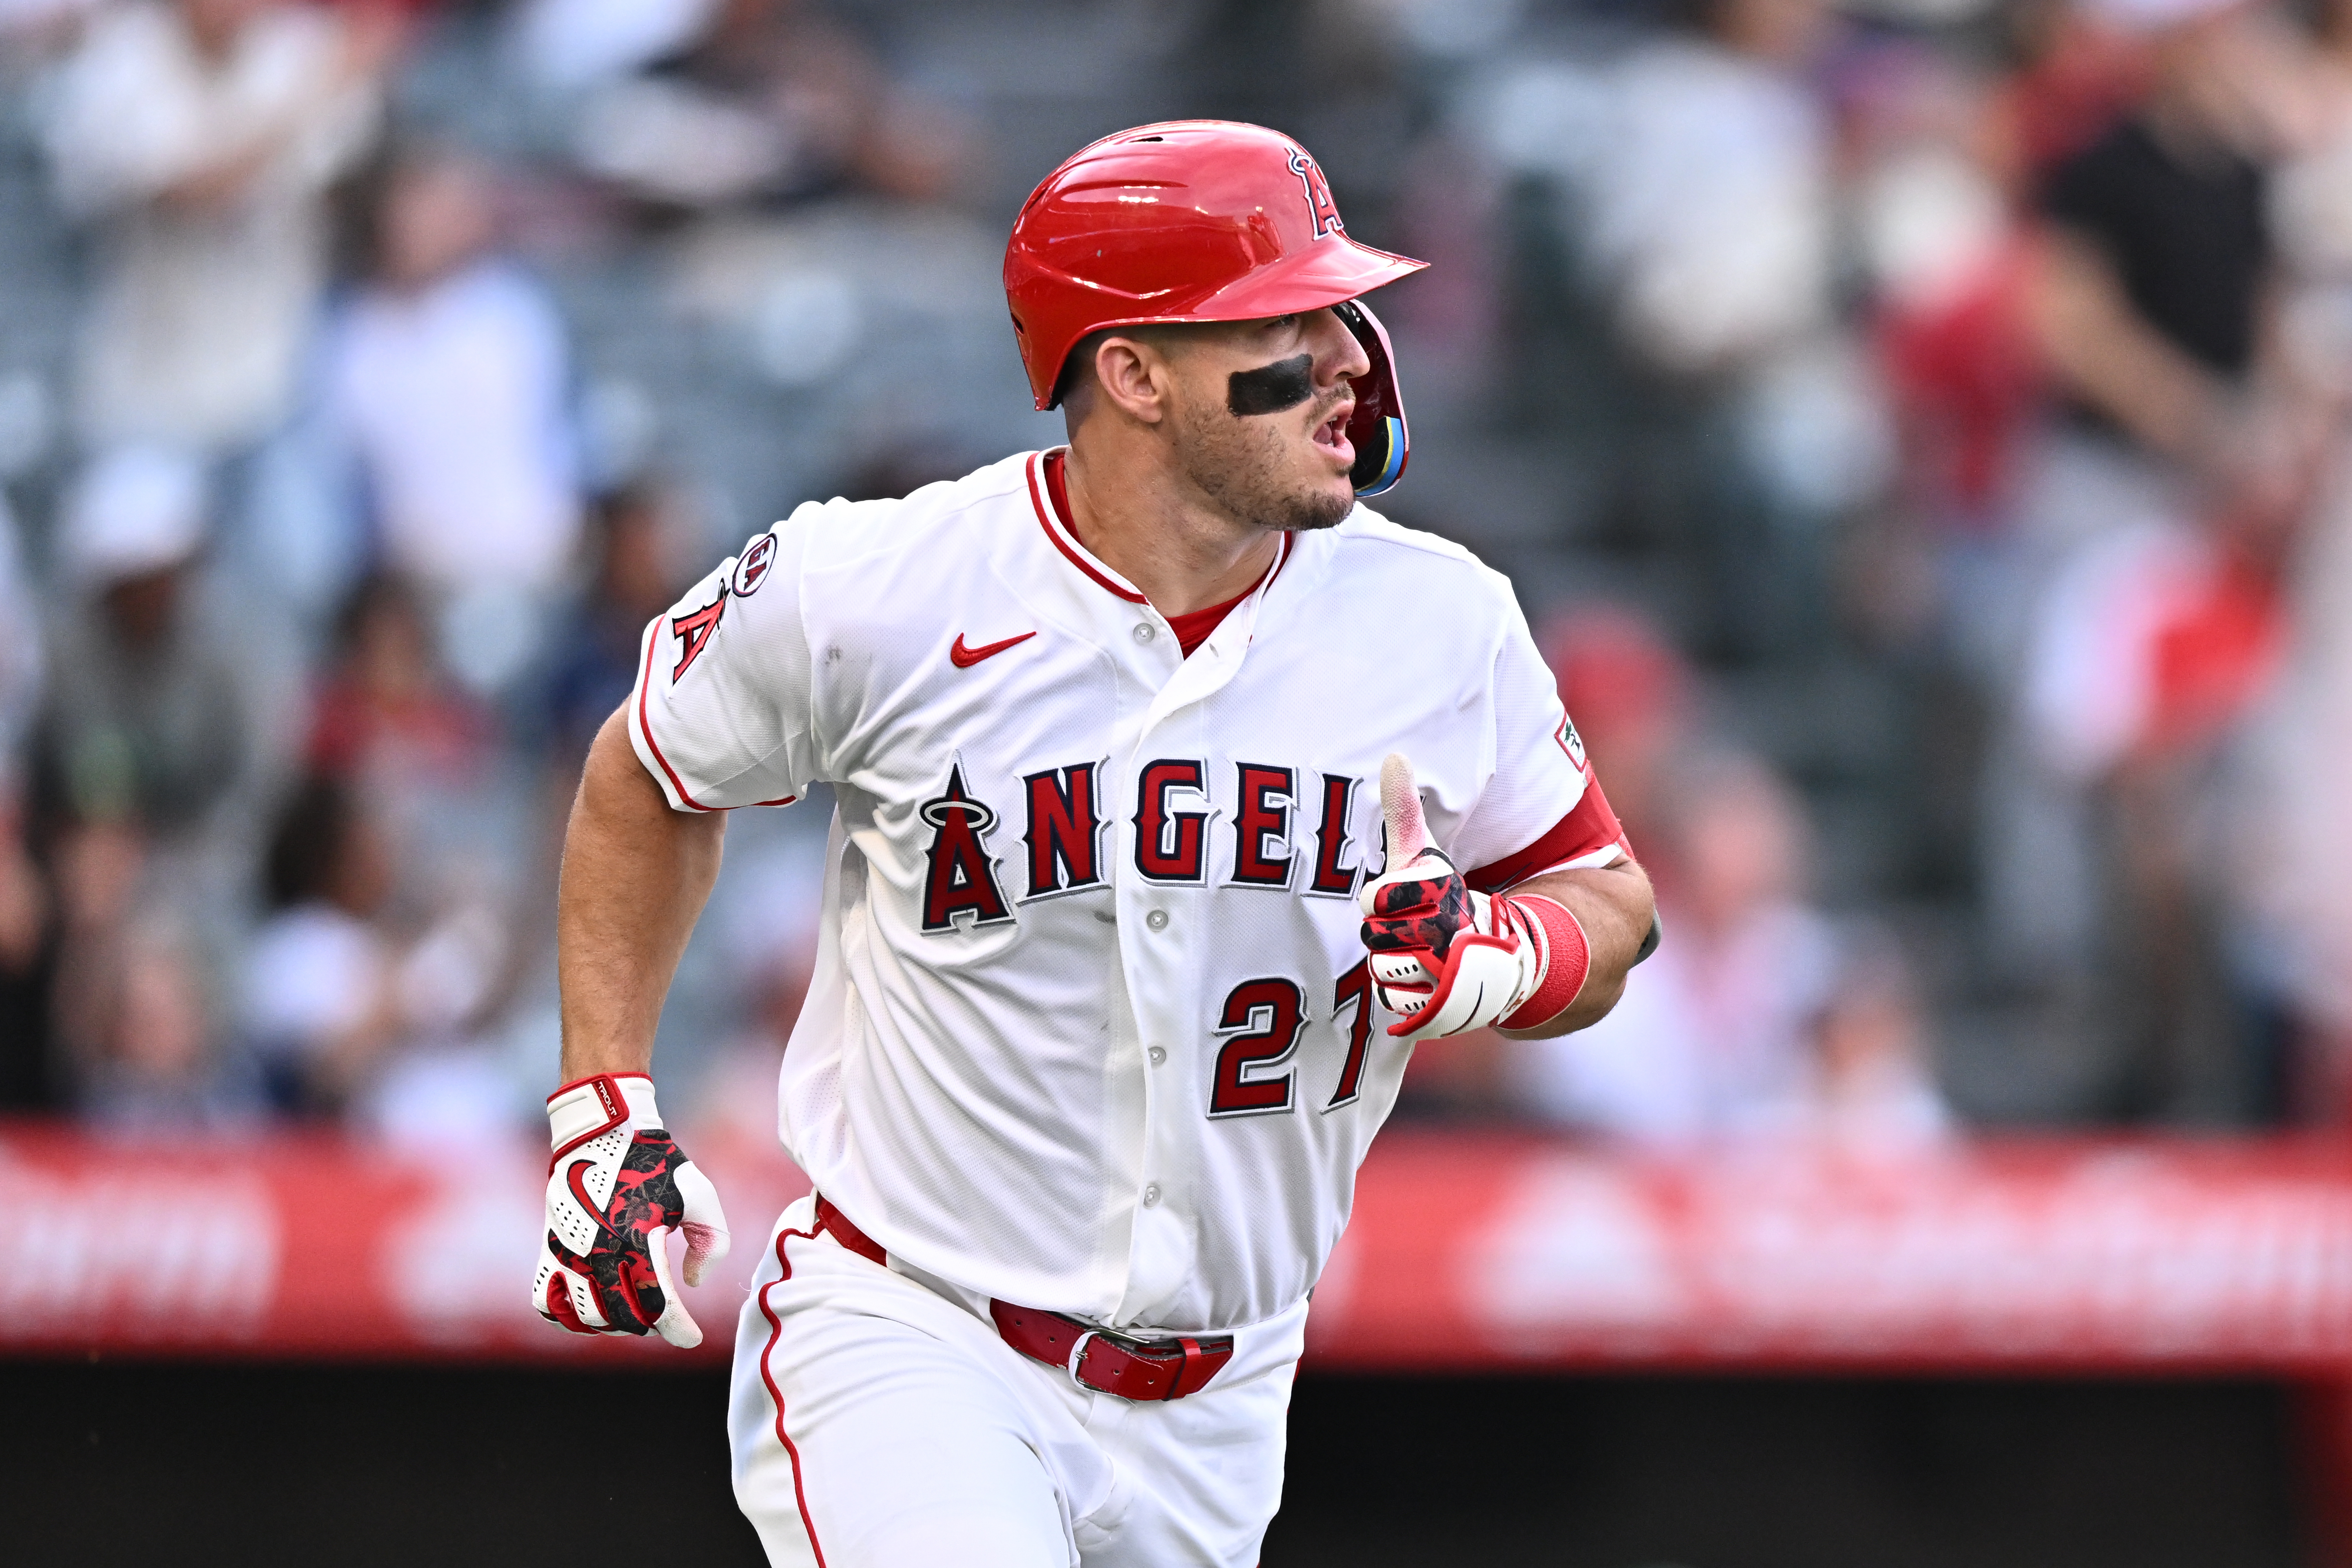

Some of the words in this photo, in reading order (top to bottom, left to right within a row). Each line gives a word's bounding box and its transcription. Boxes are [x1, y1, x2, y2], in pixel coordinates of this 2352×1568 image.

[1284, 145, 1344, 241] A
[743, 538, 771, 592] GA
[671, 577, 732, 688] A
[919, 750, 1386, 936] ANGEL
[1206, 956, 1375, 1120] 27
[598, 1081, 617, 1116] TROUT
